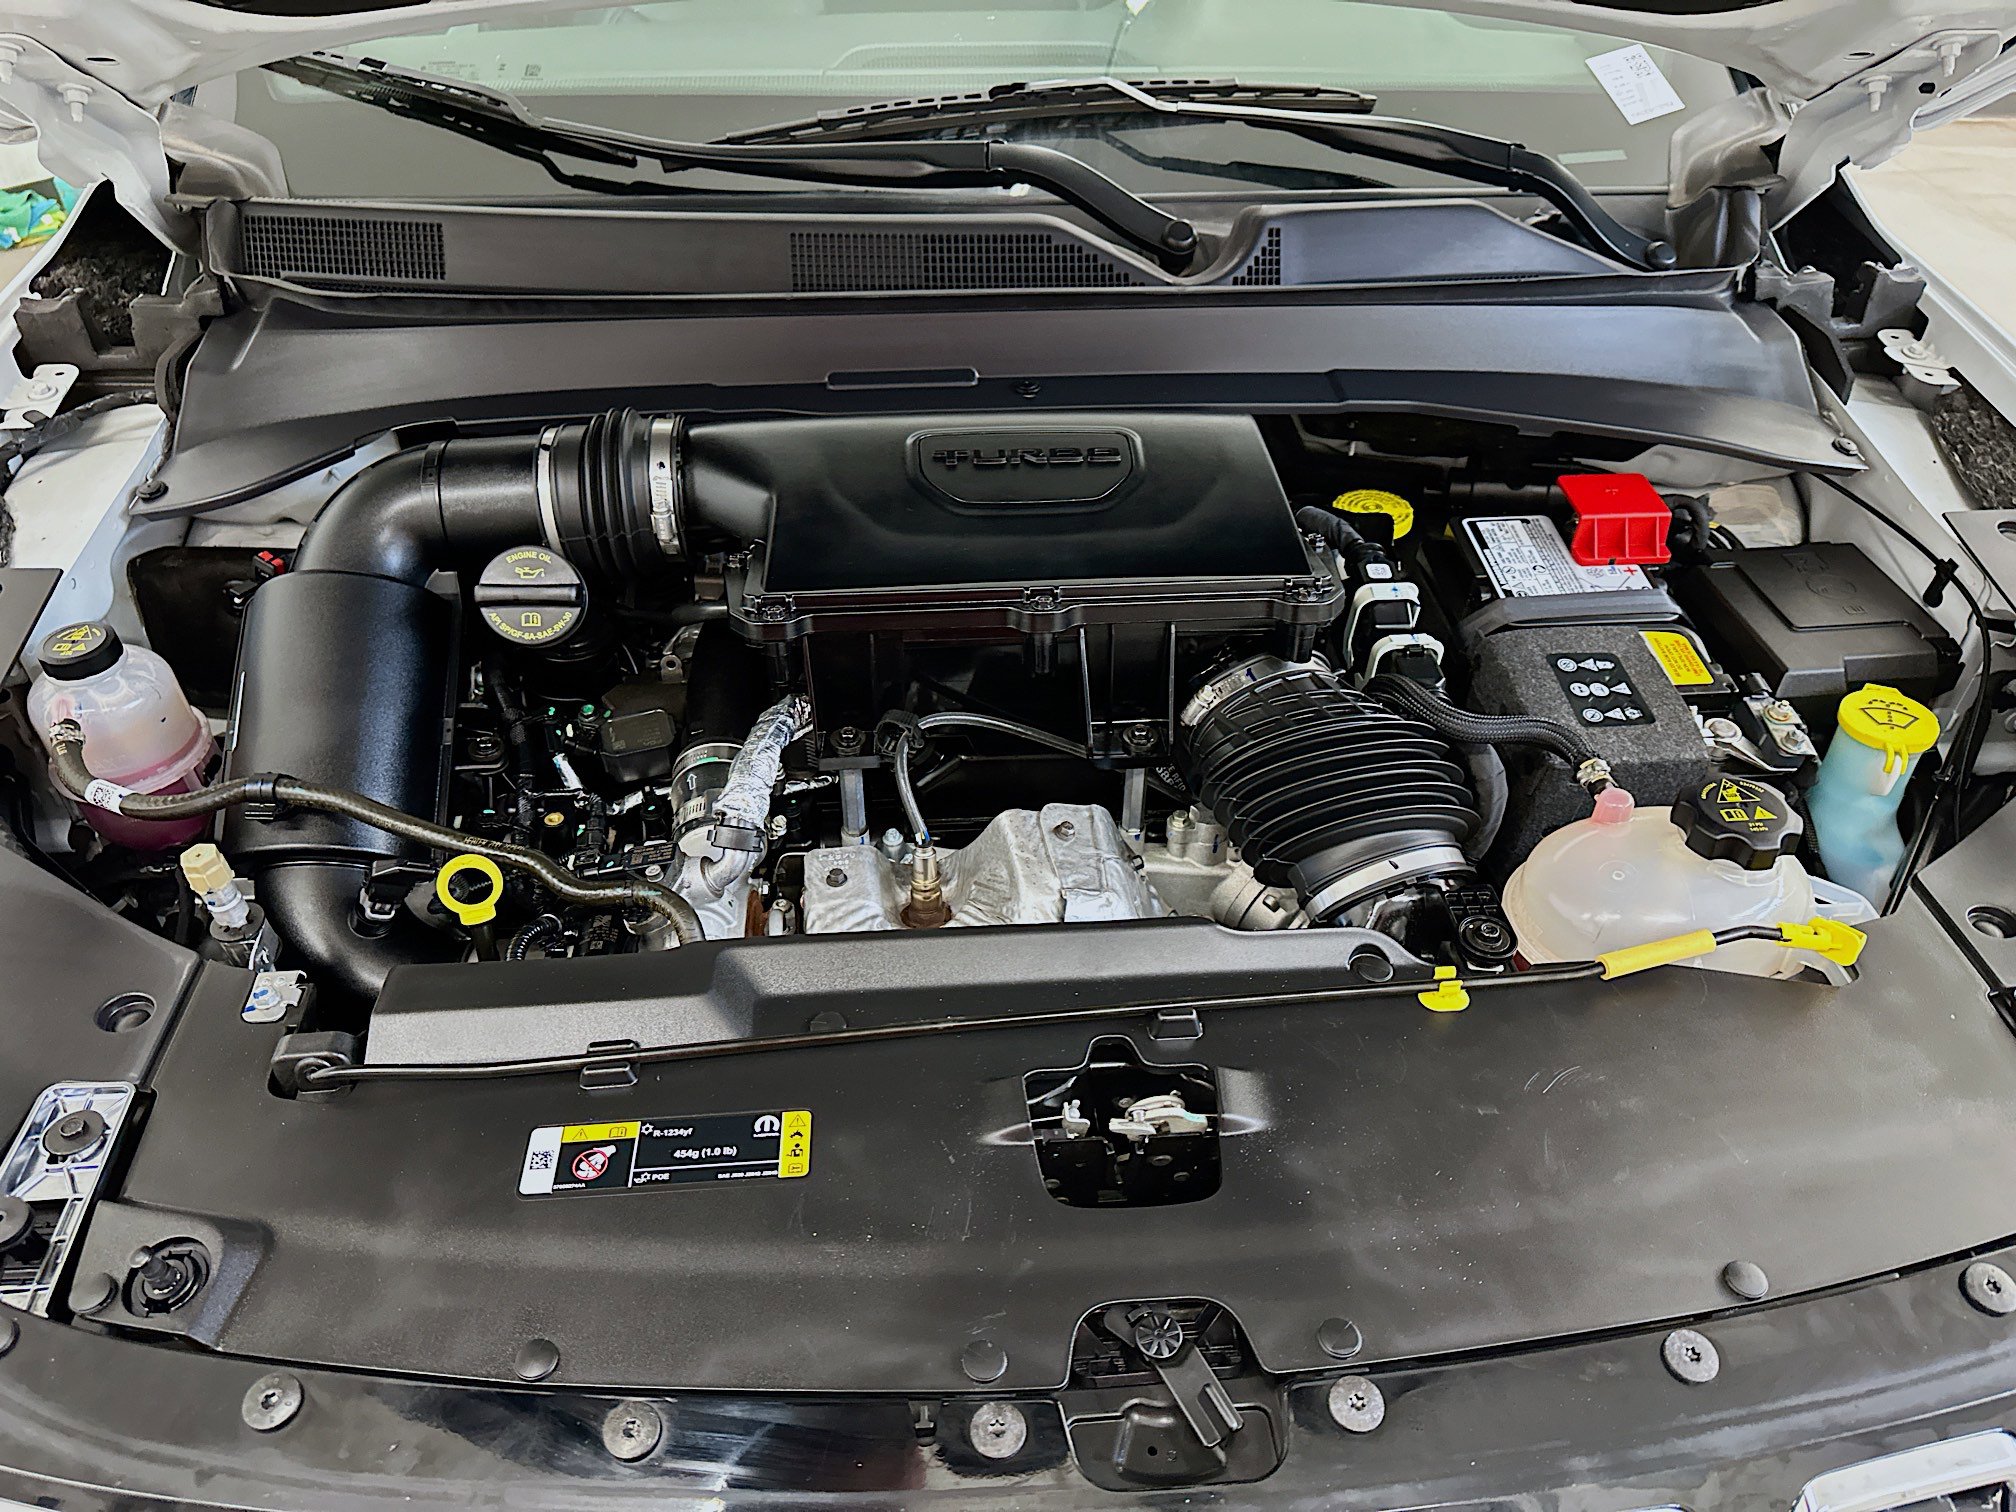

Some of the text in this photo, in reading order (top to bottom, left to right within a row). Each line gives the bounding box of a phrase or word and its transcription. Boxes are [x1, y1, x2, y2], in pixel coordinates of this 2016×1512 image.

[932, 448, 1122, 467] TURBO
[506, 551, 552, 564] ENGINE OIL
[489, 612, 501, 625] API
[653, 1127, 694, 1138] R-1234yf
[673, 1146, 737, 1159] 454g (1.0 lb)
[651, 1172, 670, 1181] POE
